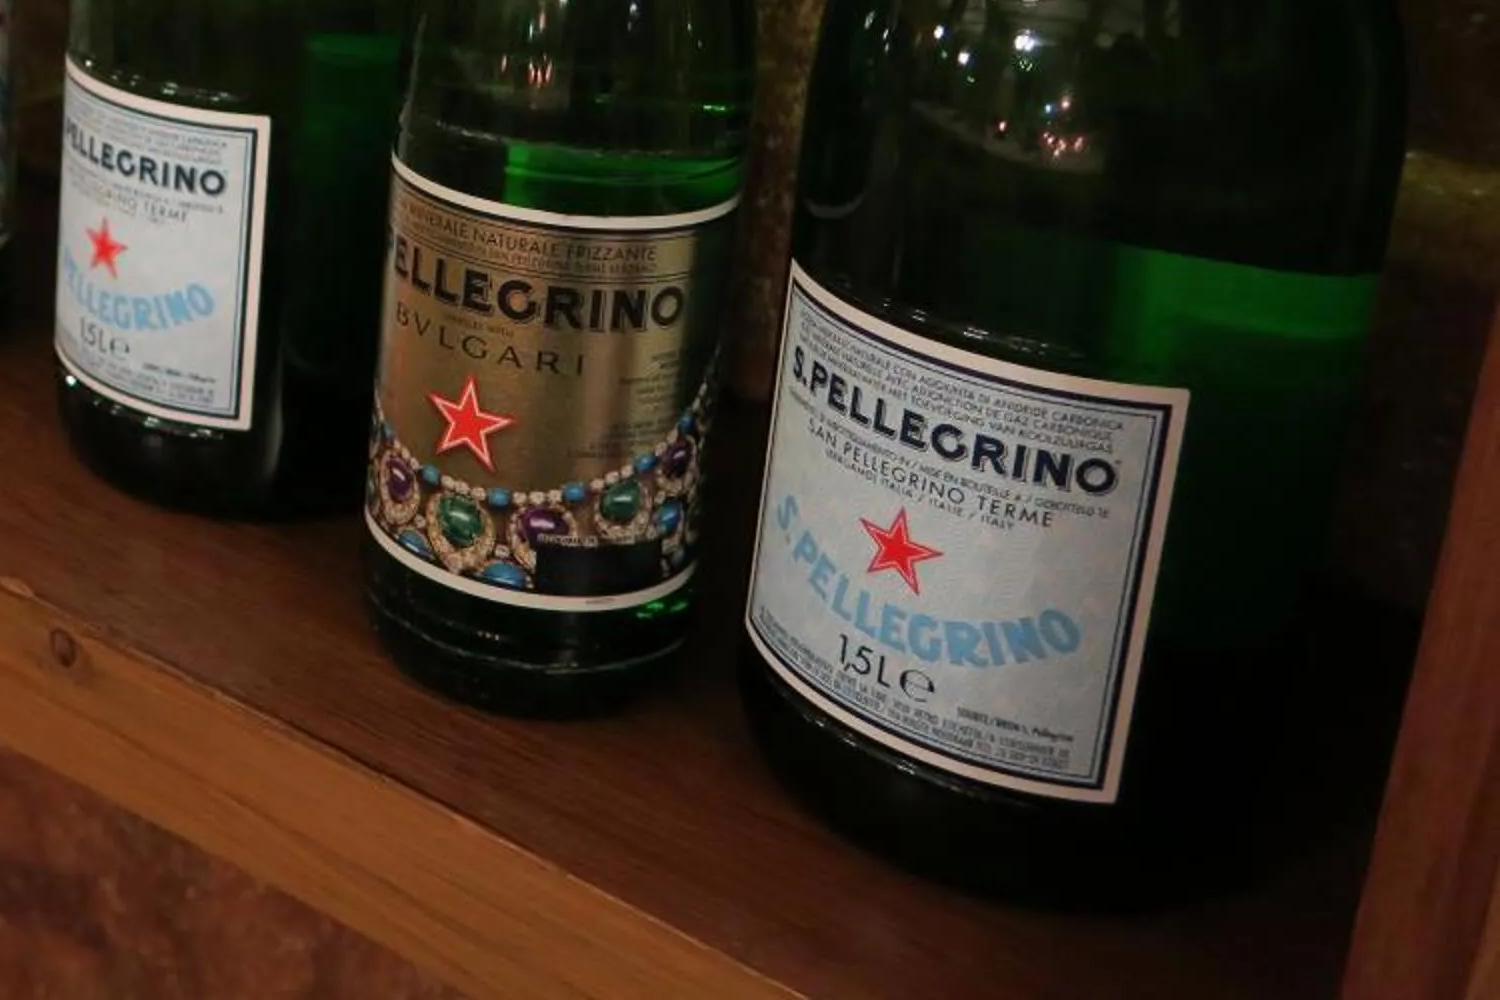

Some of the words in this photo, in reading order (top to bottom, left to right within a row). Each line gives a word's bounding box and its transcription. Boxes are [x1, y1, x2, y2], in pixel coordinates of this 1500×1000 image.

[394, 234, 685, 332] ELLEGRINO
[396, 301, 584, 377] BVLGARI
[808, 416, 838, 448] SAN
[843, 440, 966, 505] PELLEGRINO
[978, 495, 1054, 528] TERME
